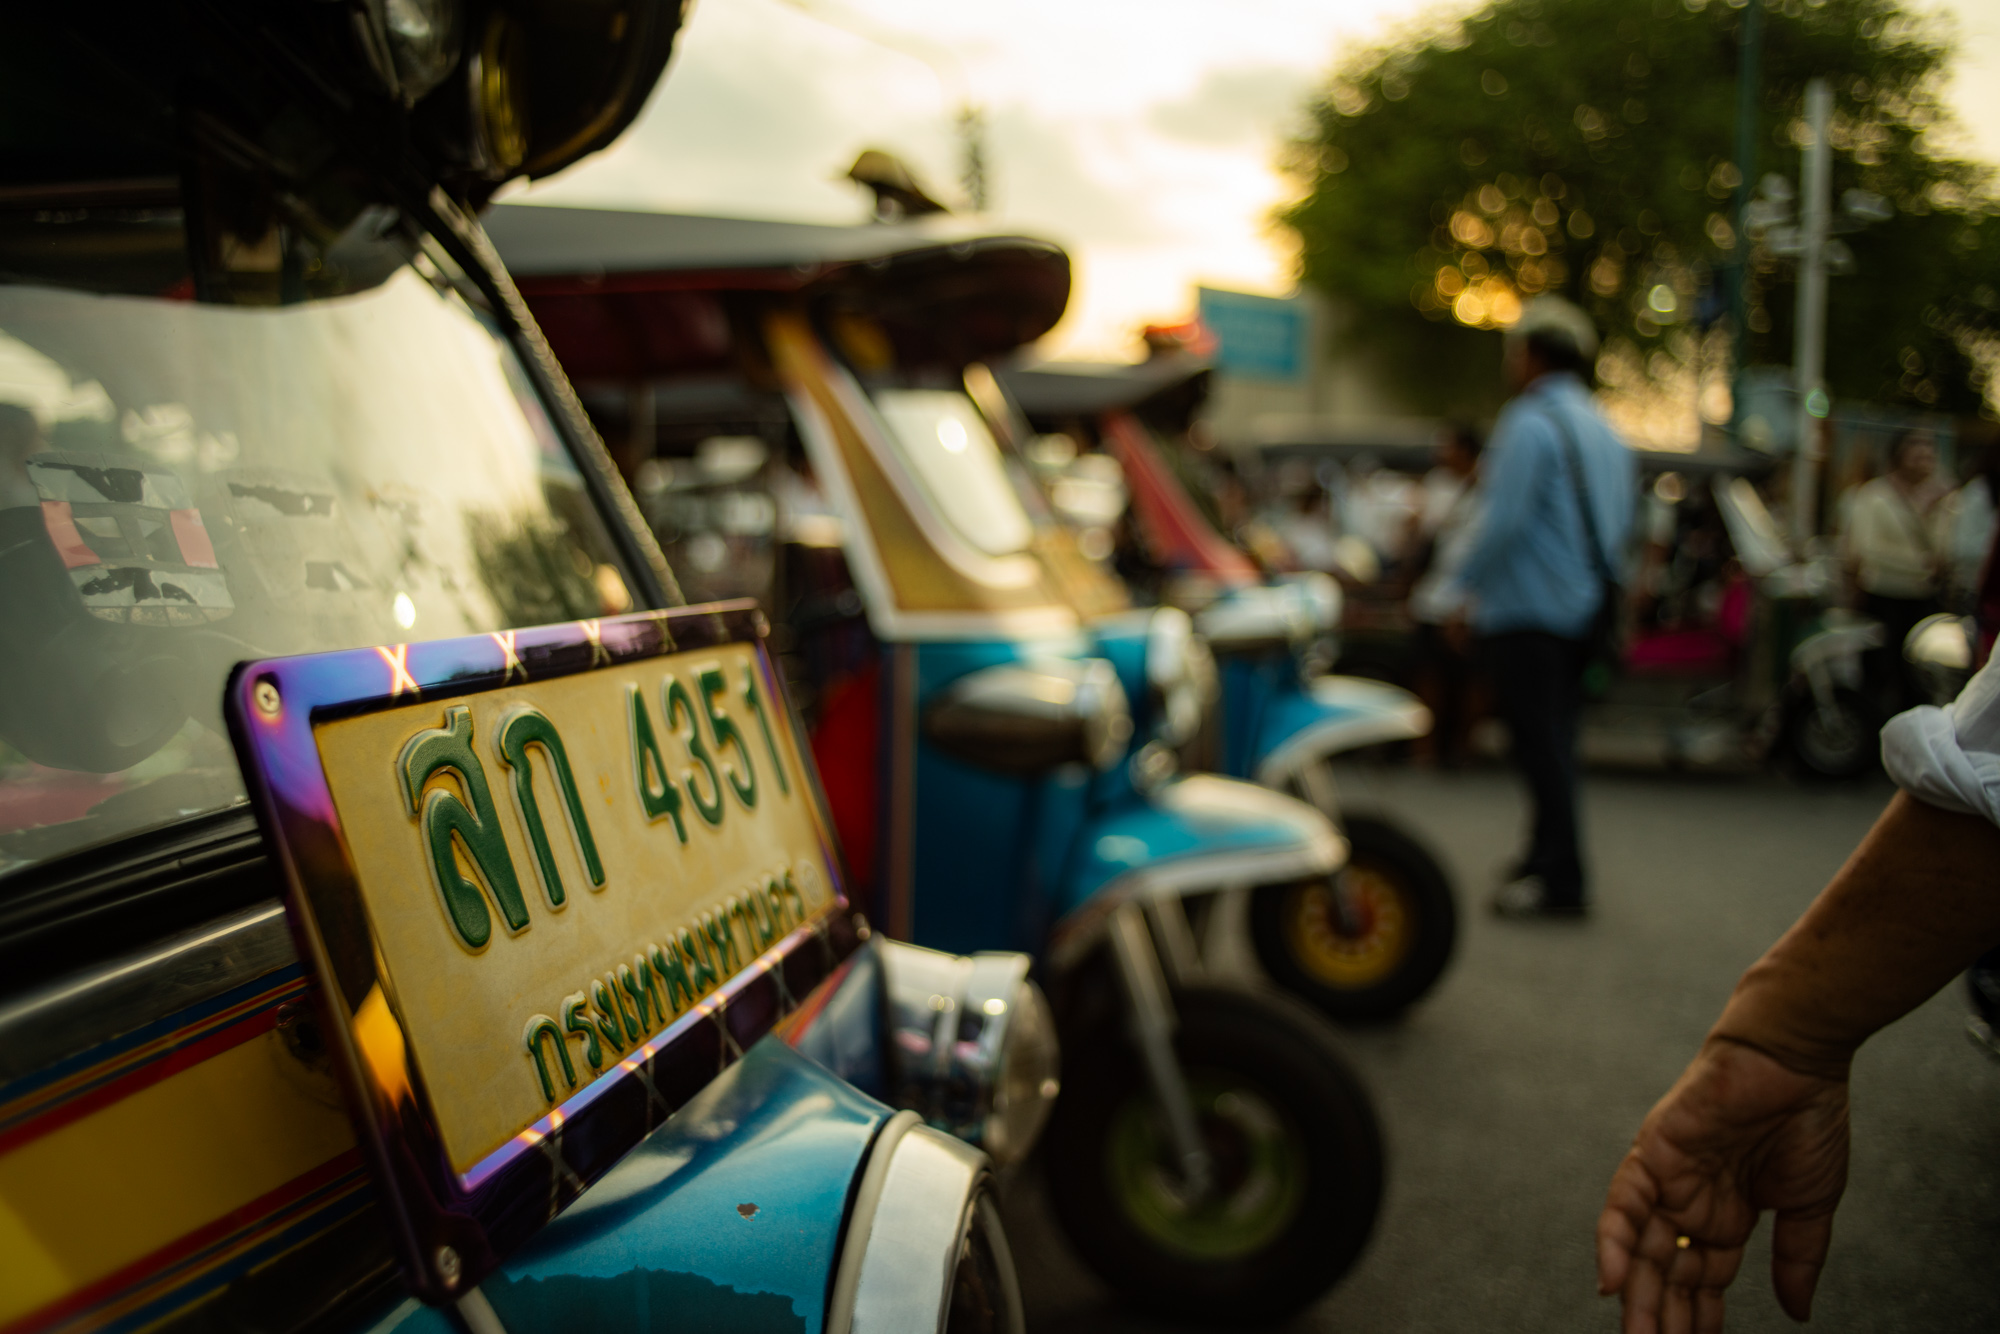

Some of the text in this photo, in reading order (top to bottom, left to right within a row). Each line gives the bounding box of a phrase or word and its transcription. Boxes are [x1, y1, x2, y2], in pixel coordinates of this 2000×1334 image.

[396, 658, 789, 955] สก 4351
[523, 864, 804, 1103] กรงเทพมหานคร
